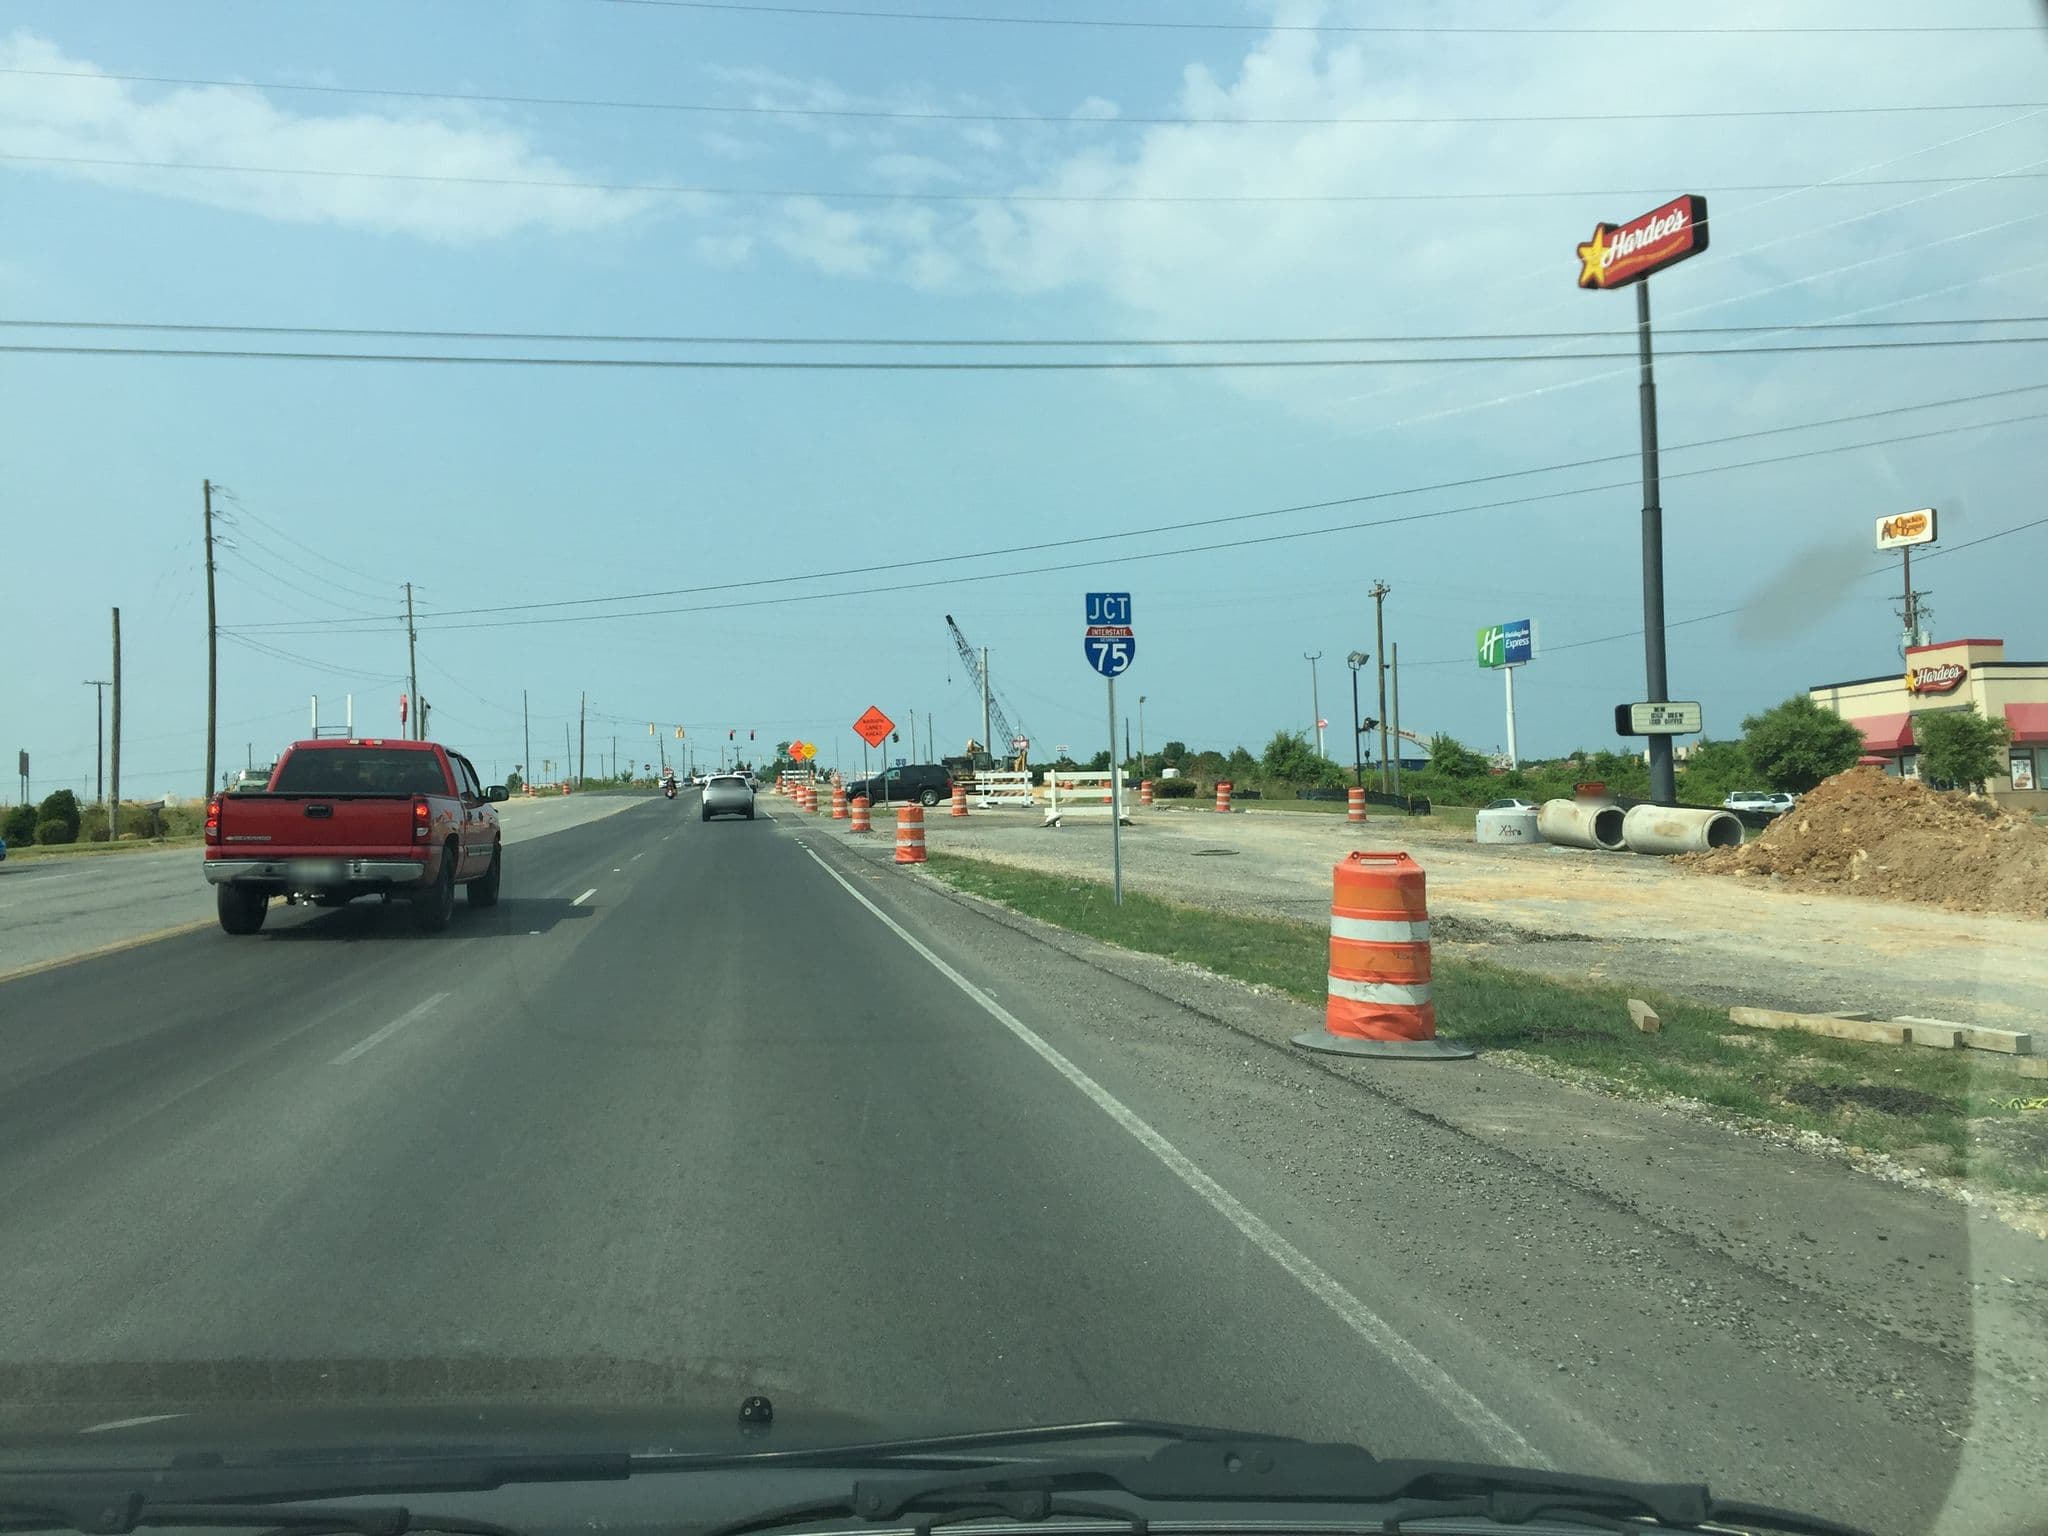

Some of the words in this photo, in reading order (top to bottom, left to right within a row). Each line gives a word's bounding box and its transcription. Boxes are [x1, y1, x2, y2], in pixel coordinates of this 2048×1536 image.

[1600, 207, 1689, 268] Hardee's
[1088, 597, 1129, 619] JCT
[1091, 628, 1128, 636] INTERSTATE
[1505, 636, 1530, 650] Express
[1092, 643, 1129, 672] 75
